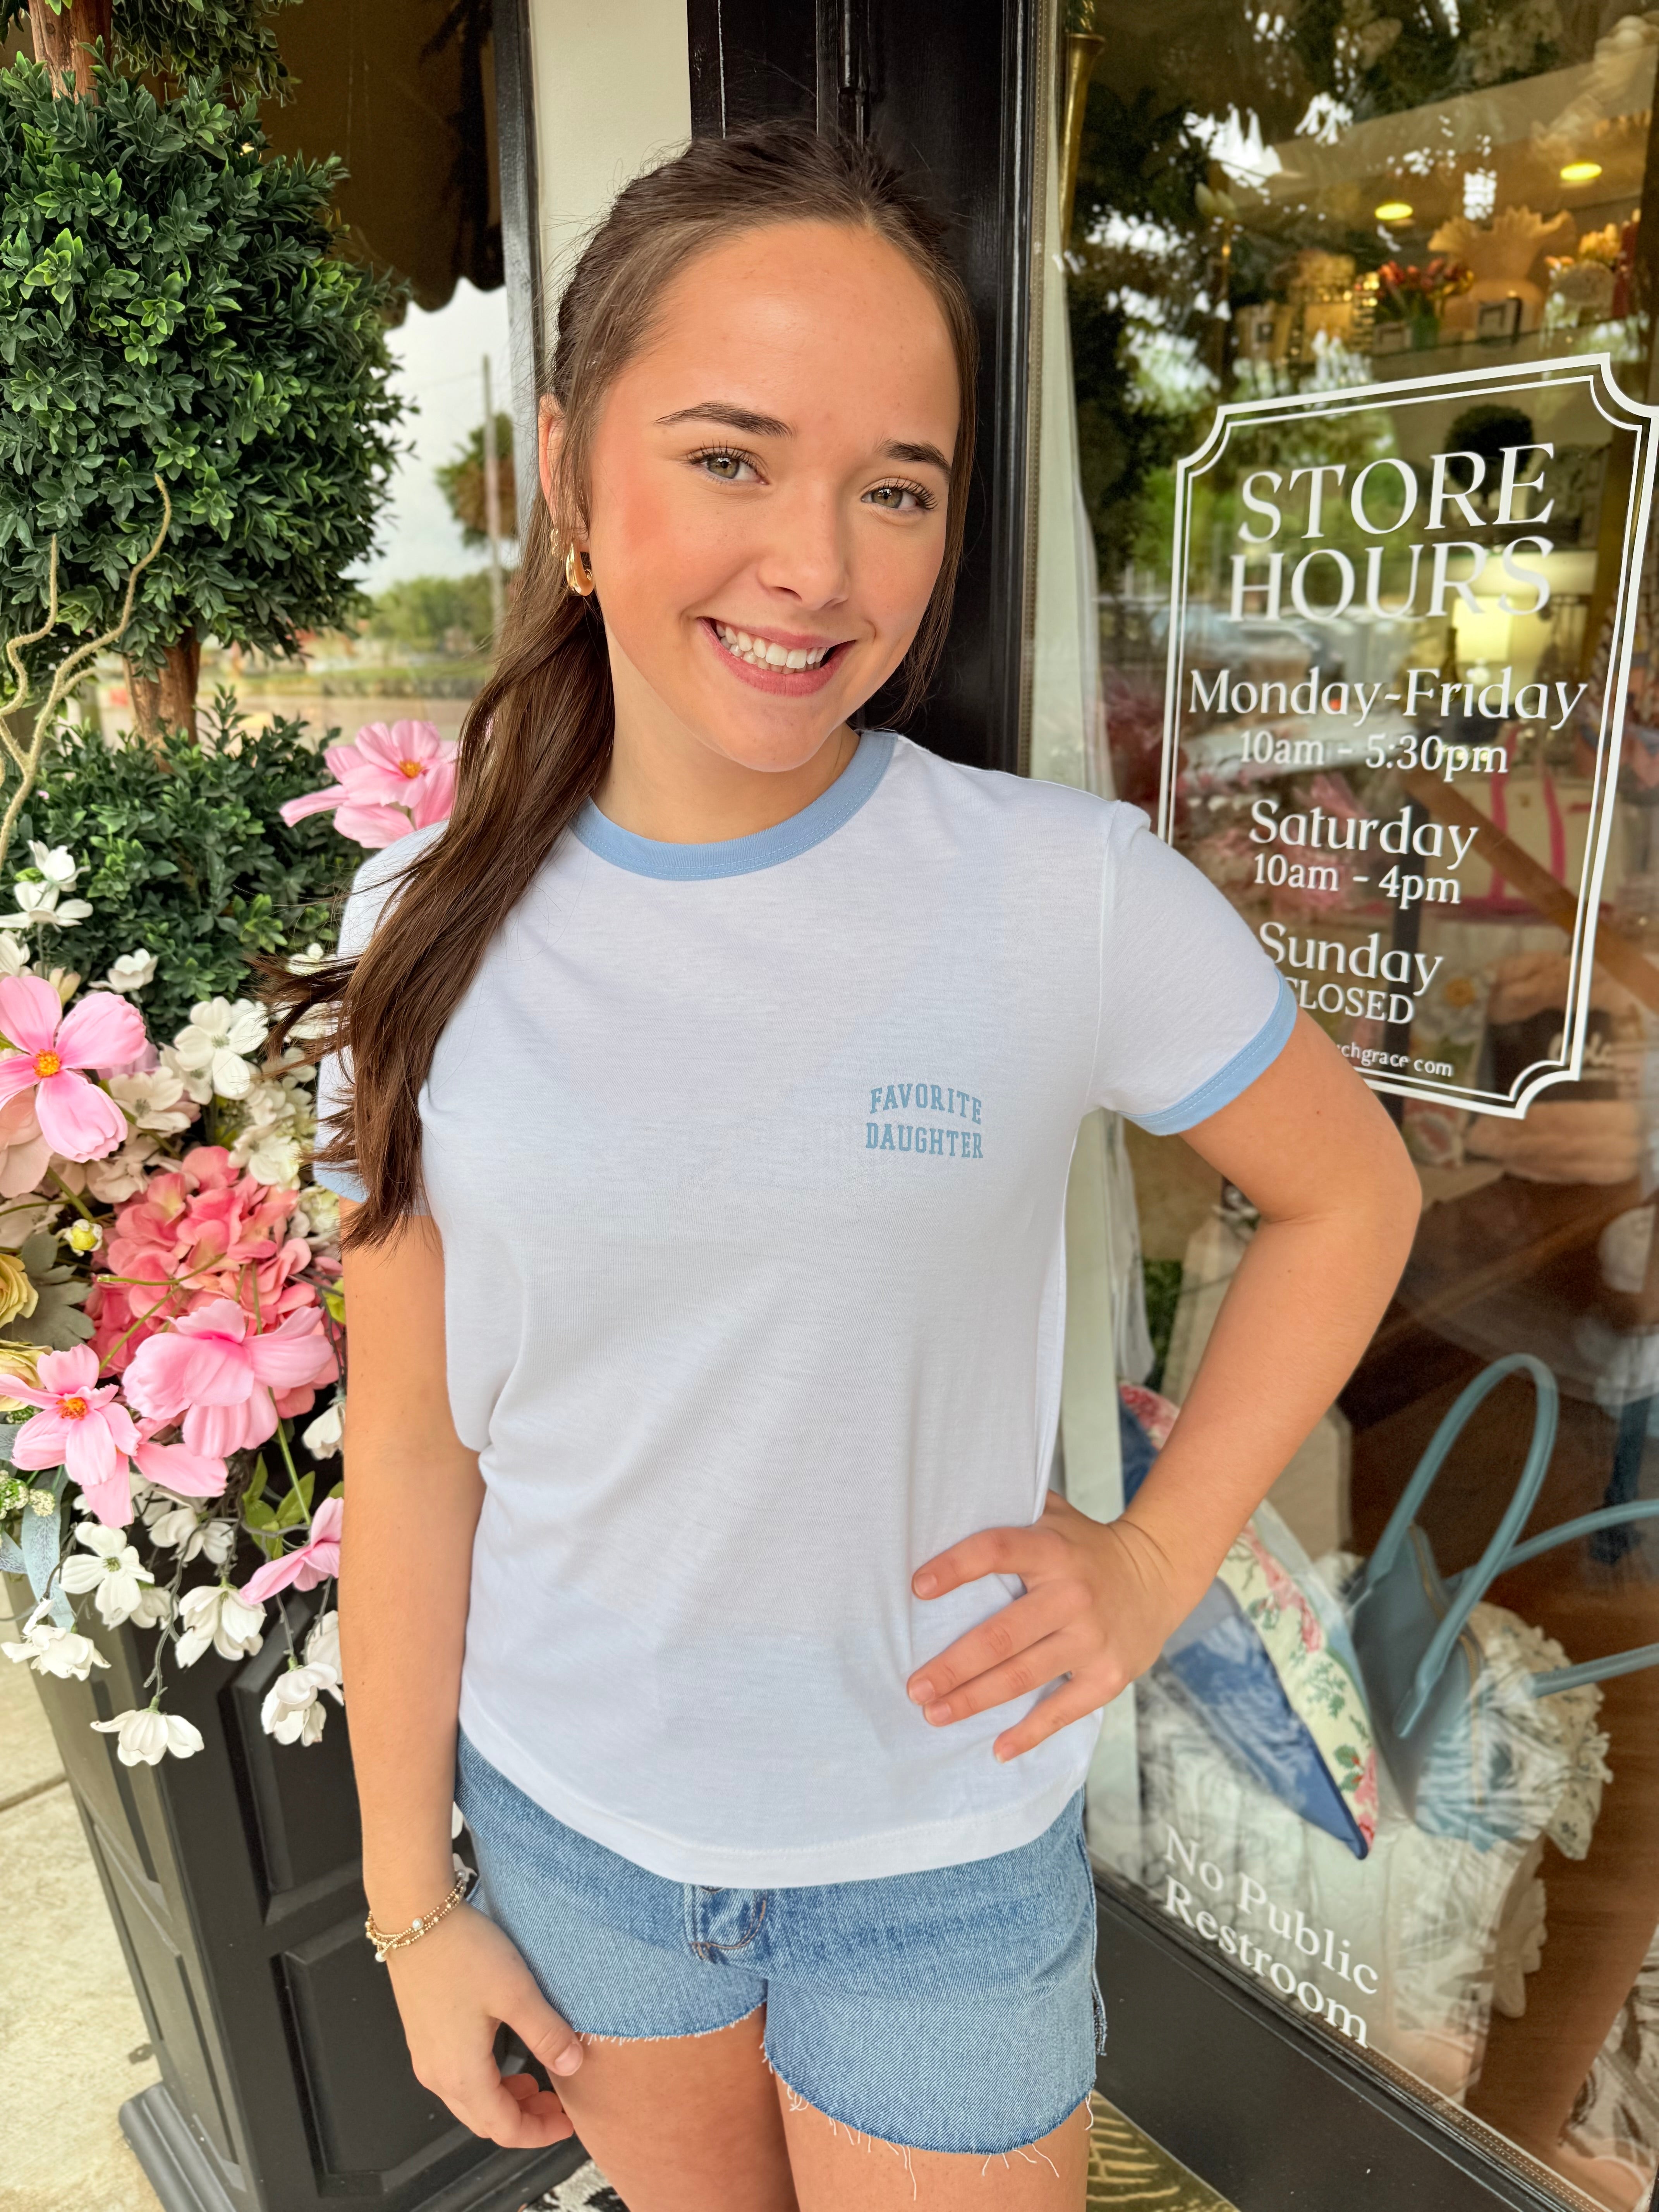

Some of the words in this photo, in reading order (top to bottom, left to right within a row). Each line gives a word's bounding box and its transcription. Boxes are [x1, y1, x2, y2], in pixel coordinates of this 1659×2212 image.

[1238, 443, 1554, 542] STORE
[1230, 536, 1554, 621] HOURS
[1188, 666, 1588, 731] Monday-Friday
[1240, 730, 1324, 765] 10am
[1365, 733, 1508, 783] 5:30pm
[1249, 799, 1479, 870] Saturday
[1254, 853, 1340, 891] 10am
[1378, 865, 1461, 910] 4pm
[1259, 921, 1444, 997] Sunday
[870, 1083, 982, 1125] FAVORITE
[866, 1122, 984, 1159] DAUGHTER
[1164, 1823, 1224, 1893] No
[1237, 1872, 1379, 1995] Public
[1164, 1875, 1369, 2049] Restroom
